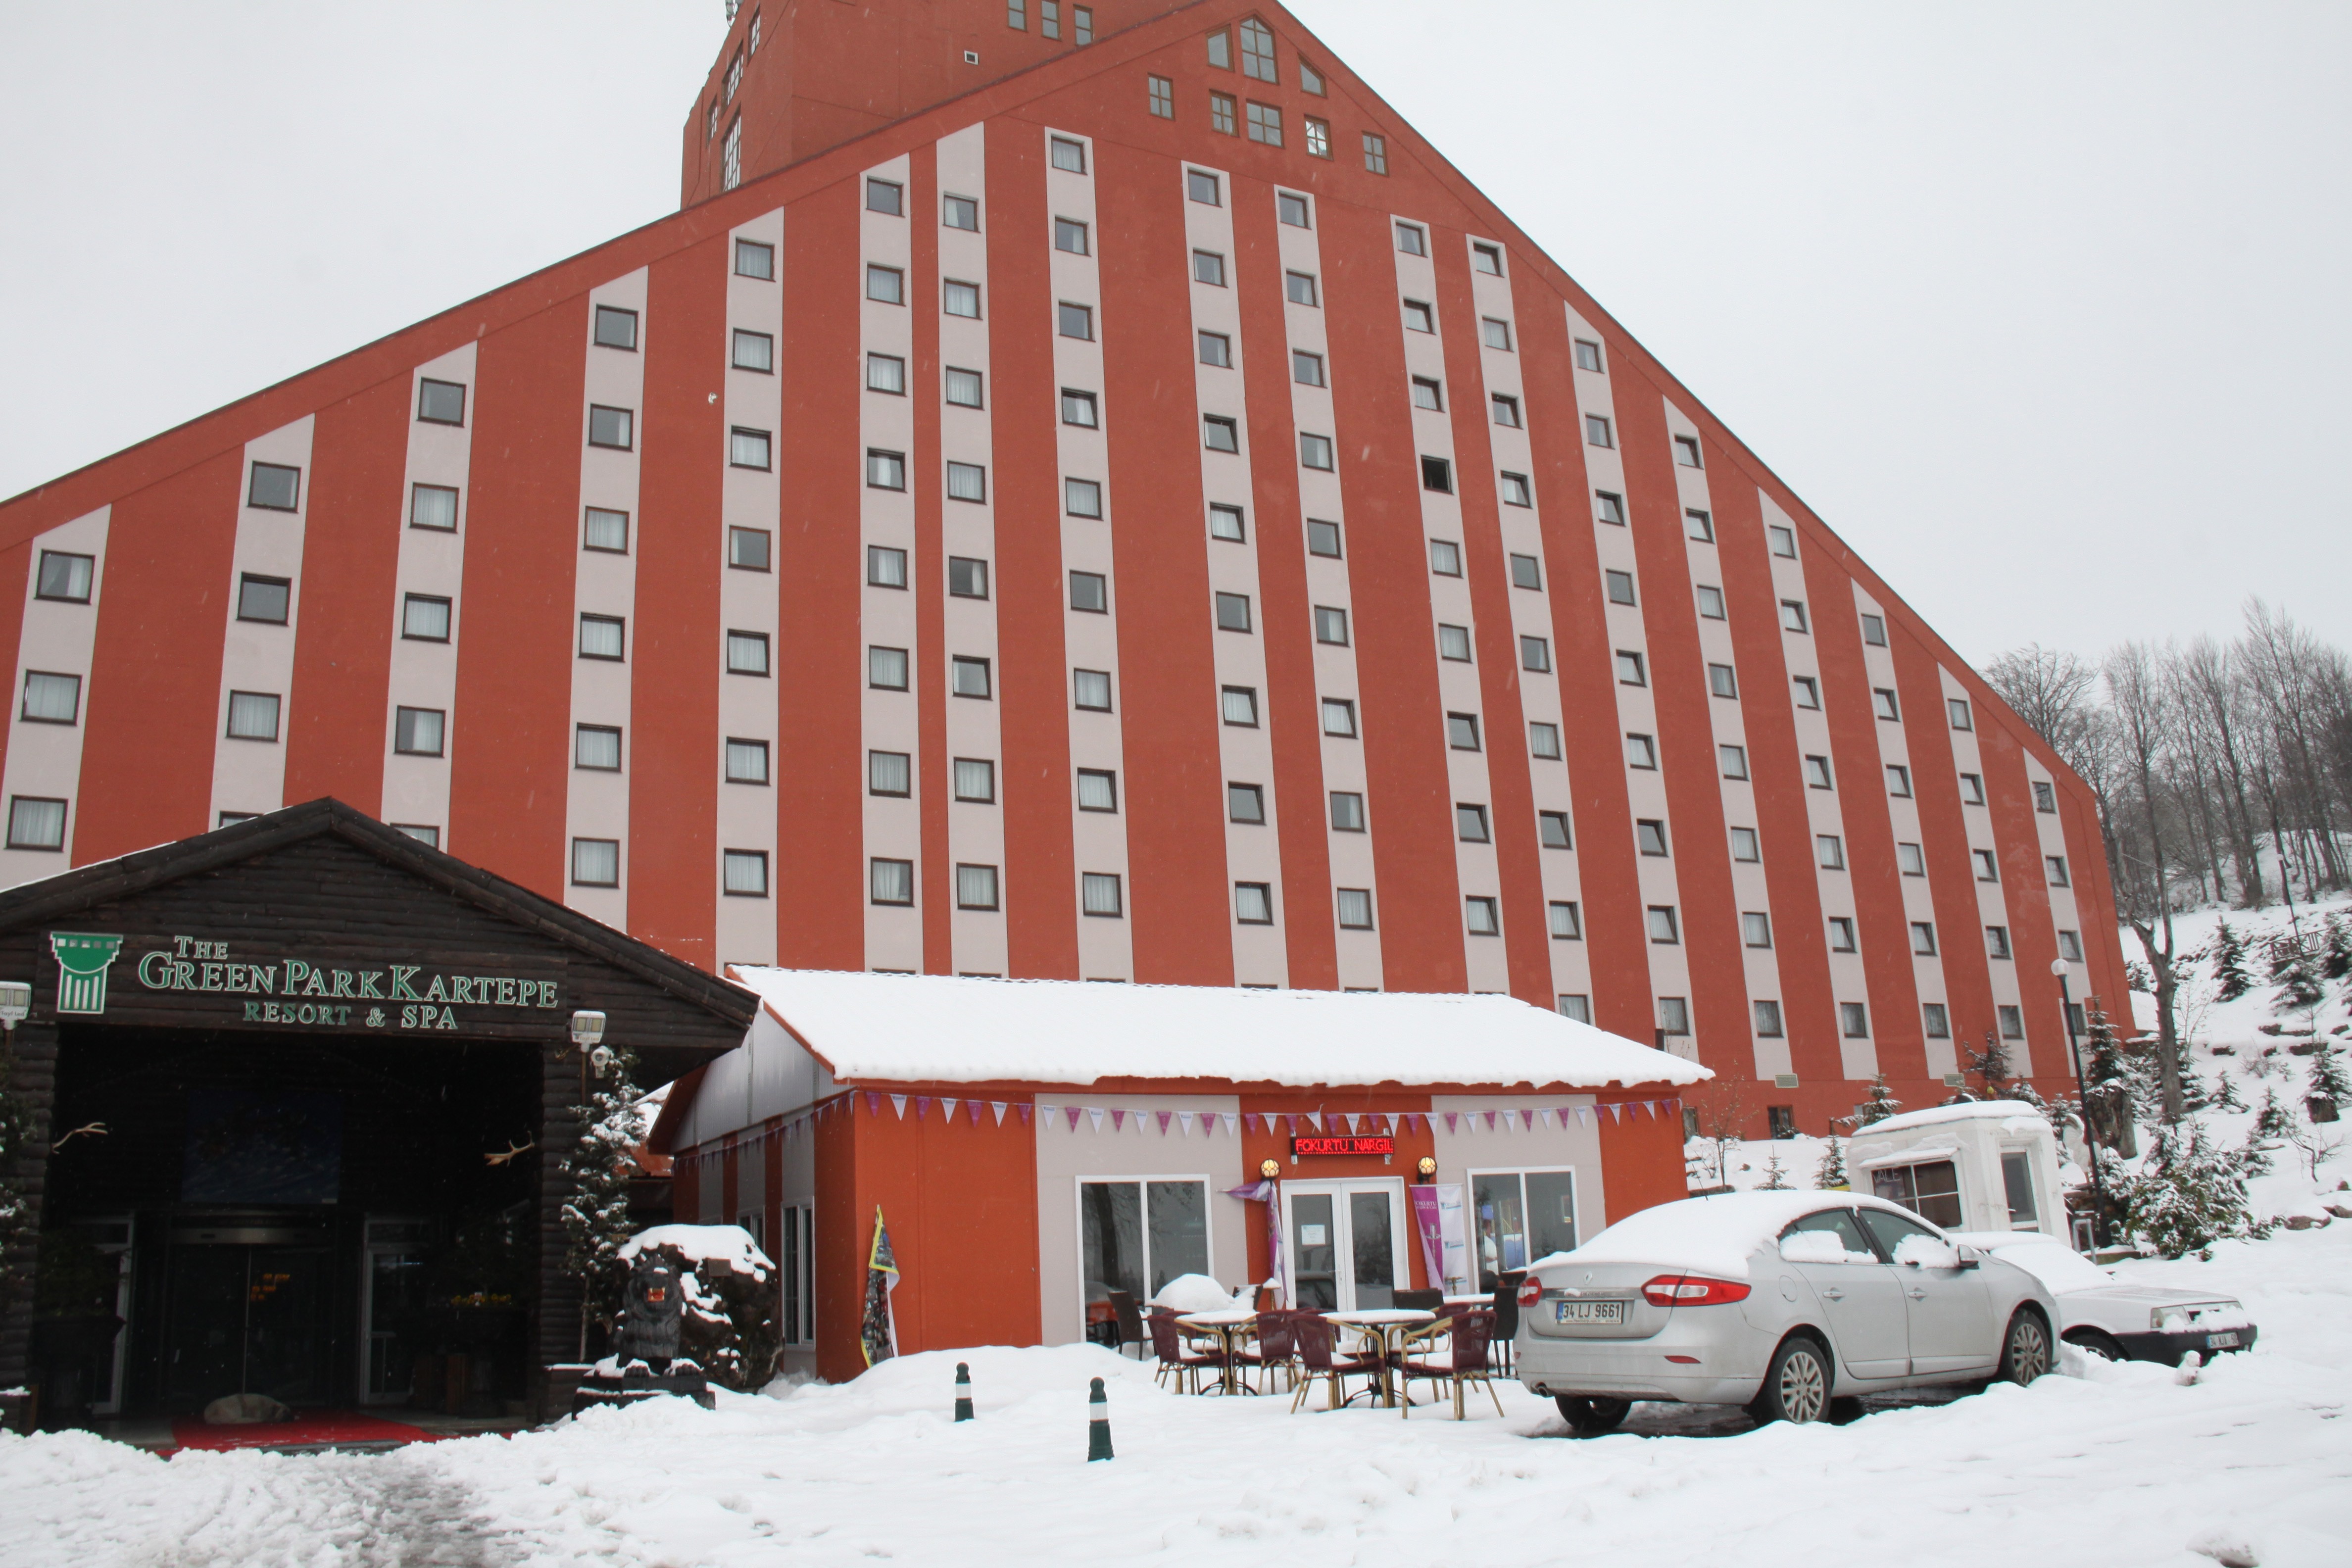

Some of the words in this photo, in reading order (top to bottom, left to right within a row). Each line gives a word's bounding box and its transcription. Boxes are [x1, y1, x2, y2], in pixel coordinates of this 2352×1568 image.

[175, 935, 228, 960] THE
[138, 951, 277, 994] GREEN
[281, 959, 385, 999] PARK
[388, 965, 559, 1008] KARTEPE
[243, 1001, 351, 1025] RESORT
[366, 1007, 386, 1028] &
[401, 1004, 458, 1029] SPA
[1296, 1139, 1349, 1152] FOKURTU
[1563, 1305, 1574, 1318] 34
[1578, 1304, 1591, 1318] LJ
[1595, 1304, 1620, 1318] 9661
